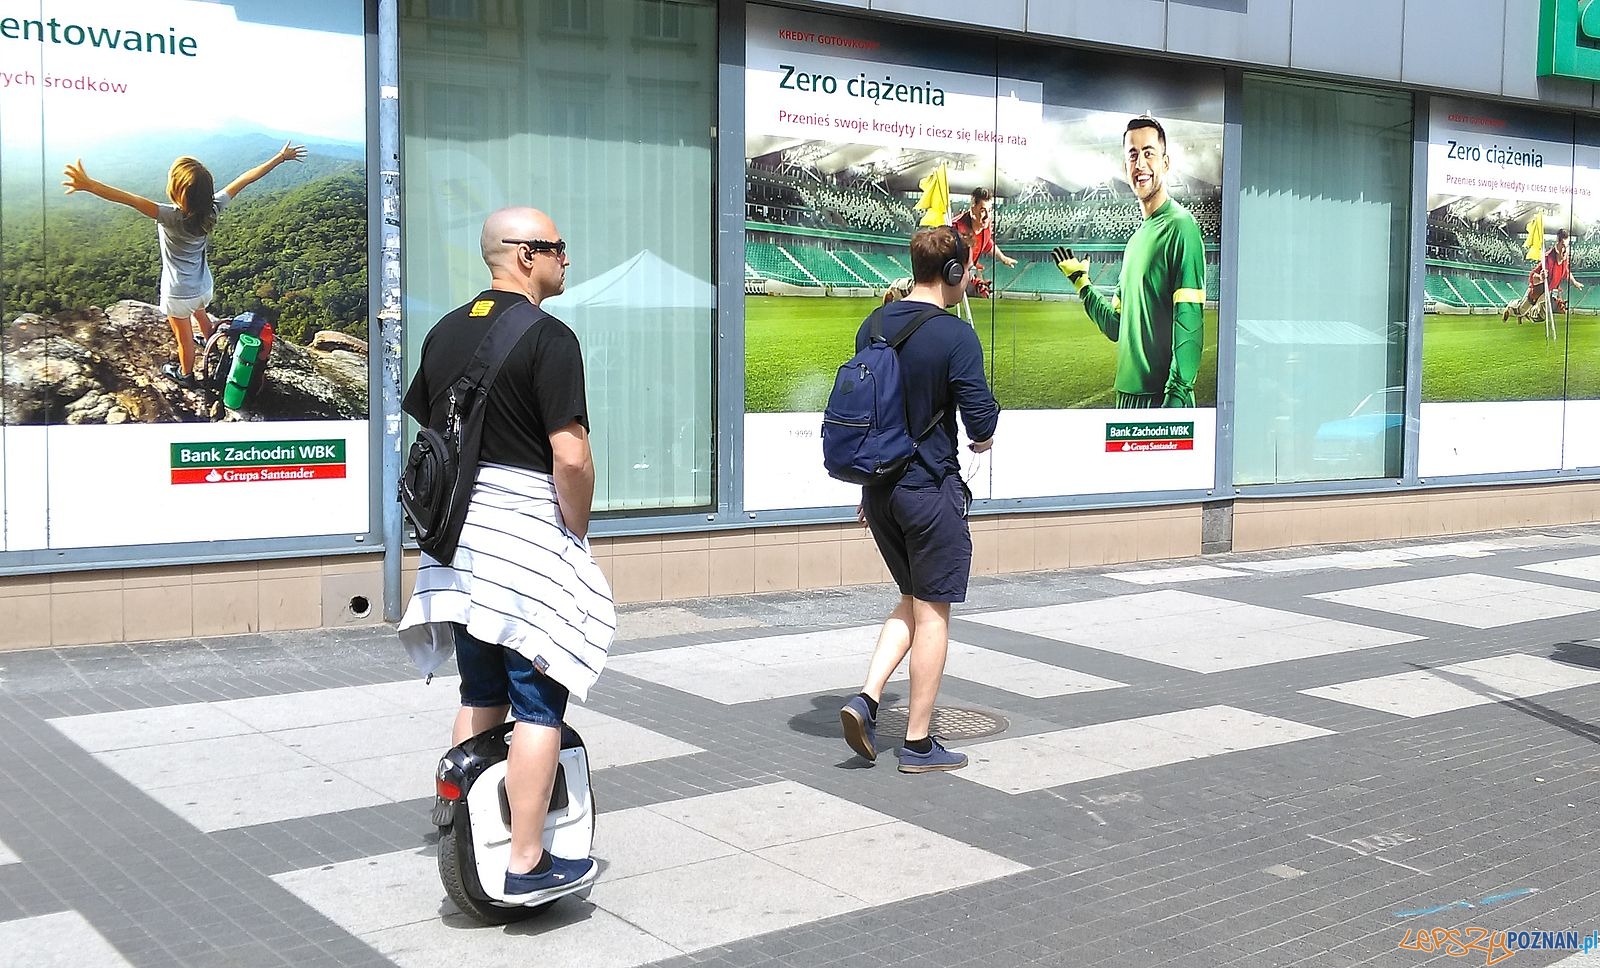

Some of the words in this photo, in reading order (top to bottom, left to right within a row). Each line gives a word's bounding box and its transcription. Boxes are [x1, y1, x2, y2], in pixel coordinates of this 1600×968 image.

[0, 17, 198, 57] entowanie
[779, 29, 815, 43] KREDYT
[44, 72, 128, 94] środków
[779, 64, 837, 95] Zero
[847, 73, 945, 106] ciążenia
[779, 110, 830, 127] Przenieś
[834, 117, 869, 133] swoje
[873, 119, 915, 137] kredyty
[919, 123, 923, 136] i
[926, 125, 953, 139] ciesz
[956, 128, 971, 143] się
[1447, 140, 1481, 162] Zero
[1486, 144, 1543, 169] ciążenia
[1478, 179, 1498, 190] swoje
[1500, 180, 1526, 192] kredyty
[1110, 427, 1131, 437] Bank
[1132, 426, 1168, 437] Zachodni
[1169, 425, 1190, 436] WBK
[180, 447, 221, 463] Bank
[224, 445, 295, 462] Zachodni
[299, 445, 336, 459] WBK
[223, 470, 259, 482] Grupa
[261, 468, 315, 480] Santander
